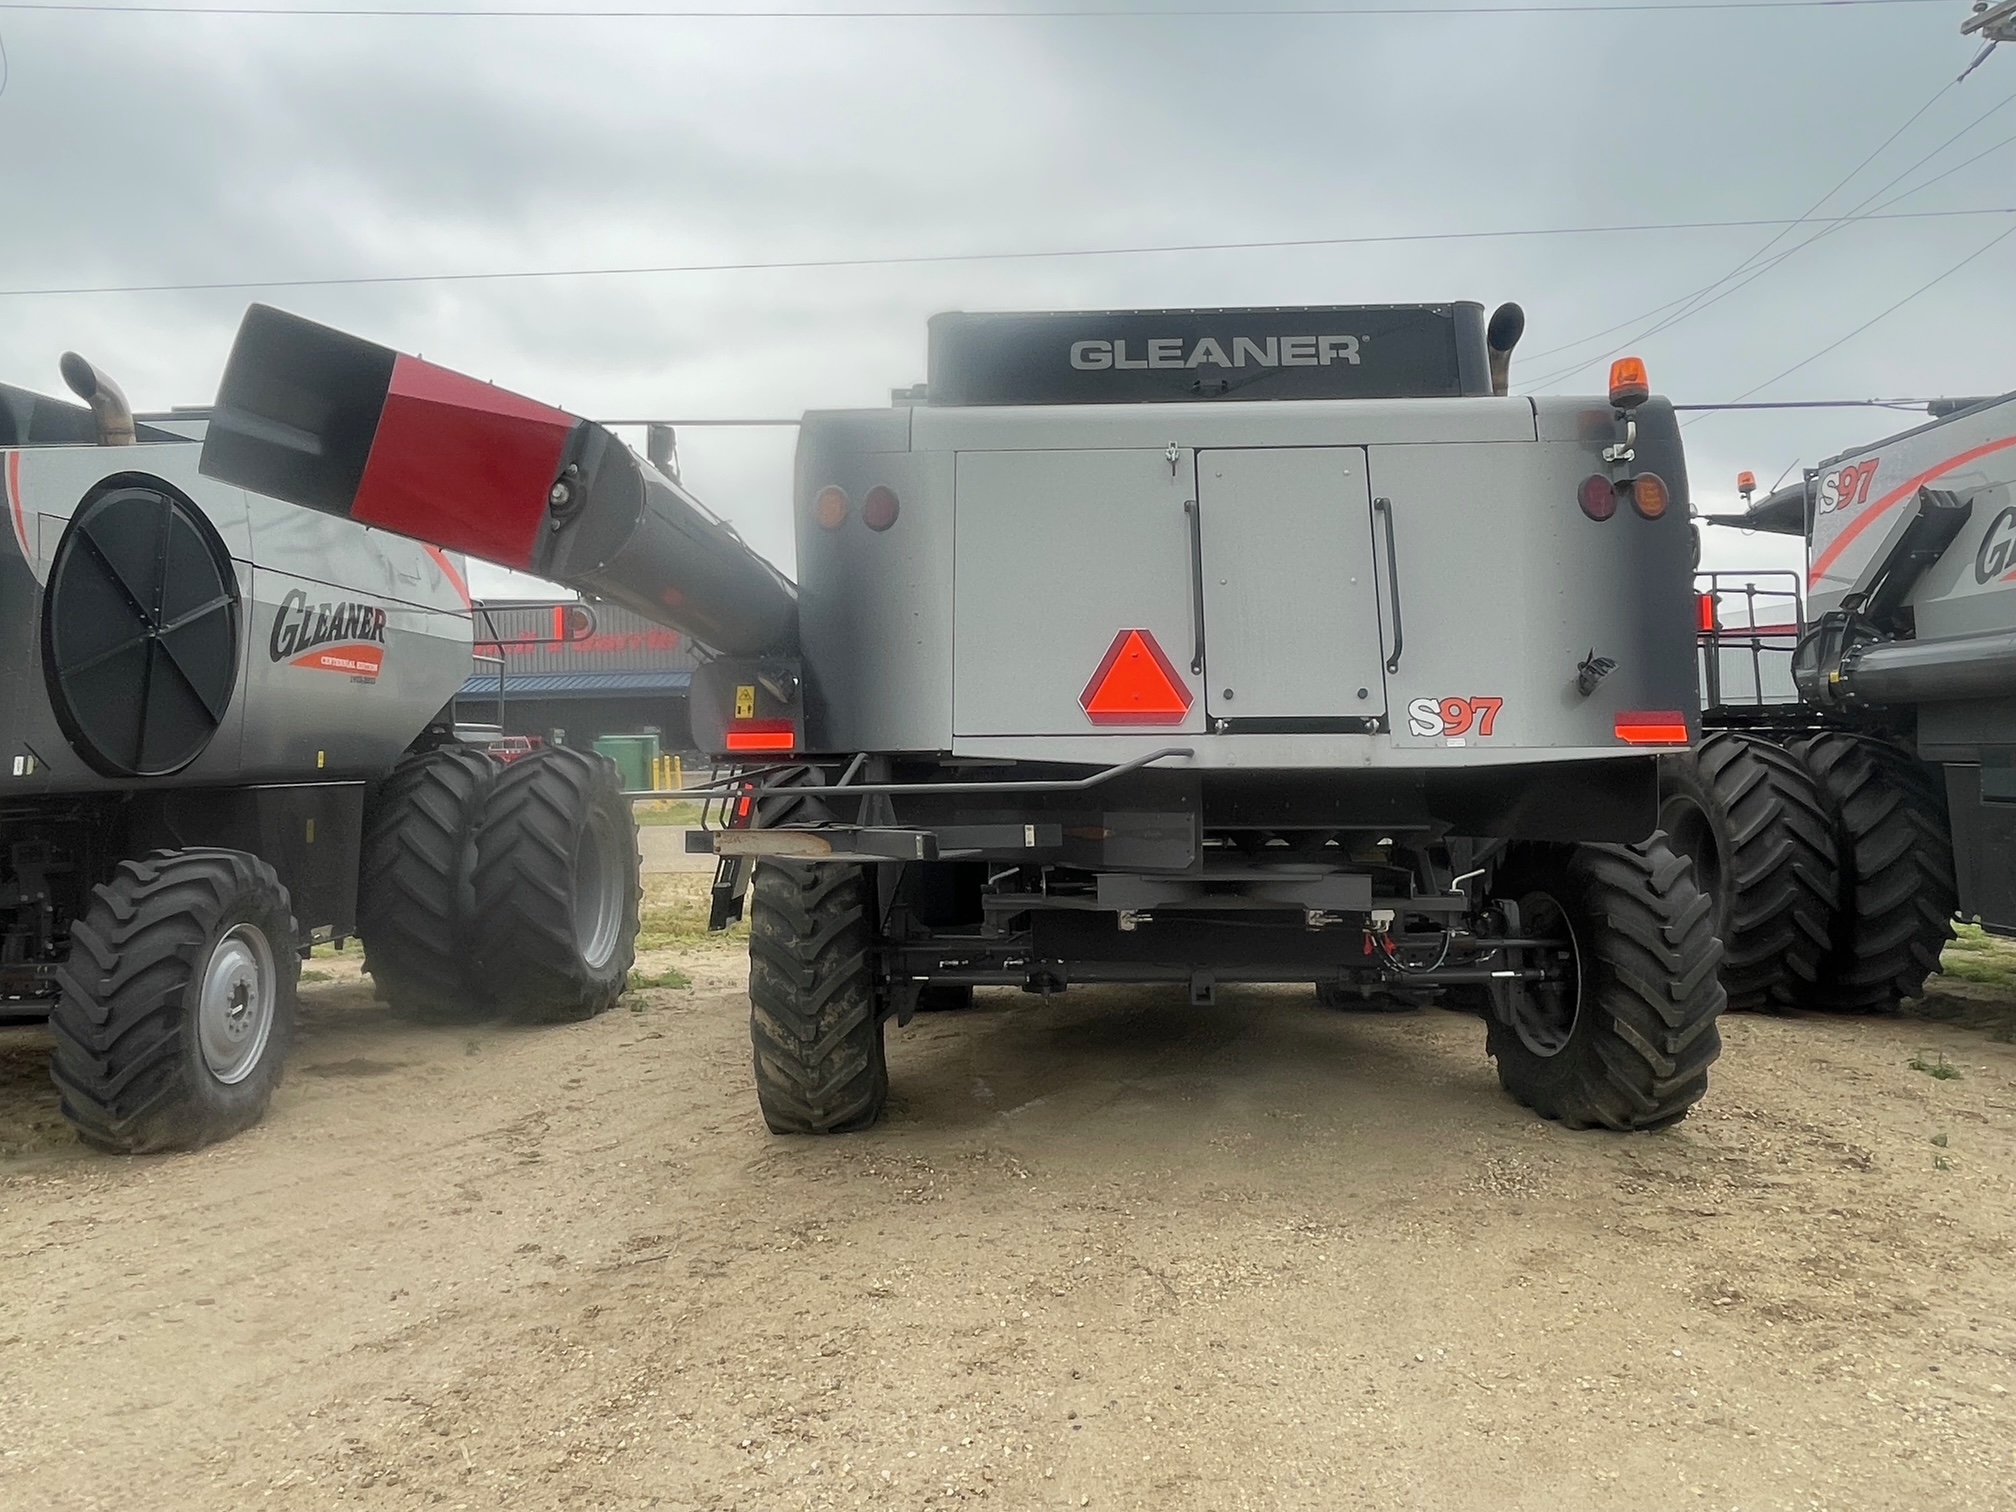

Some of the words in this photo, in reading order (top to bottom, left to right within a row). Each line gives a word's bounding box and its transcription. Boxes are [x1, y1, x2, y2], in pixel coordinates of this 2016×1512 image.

[1070, 335, 1361, 370] GLEANER
[1818, 457, 1880, 515] S97
[1974, 505, 2016, 586] G
[270, 588, 388, 663] GLEANER
[1408, 696, 1504, 737] S97
